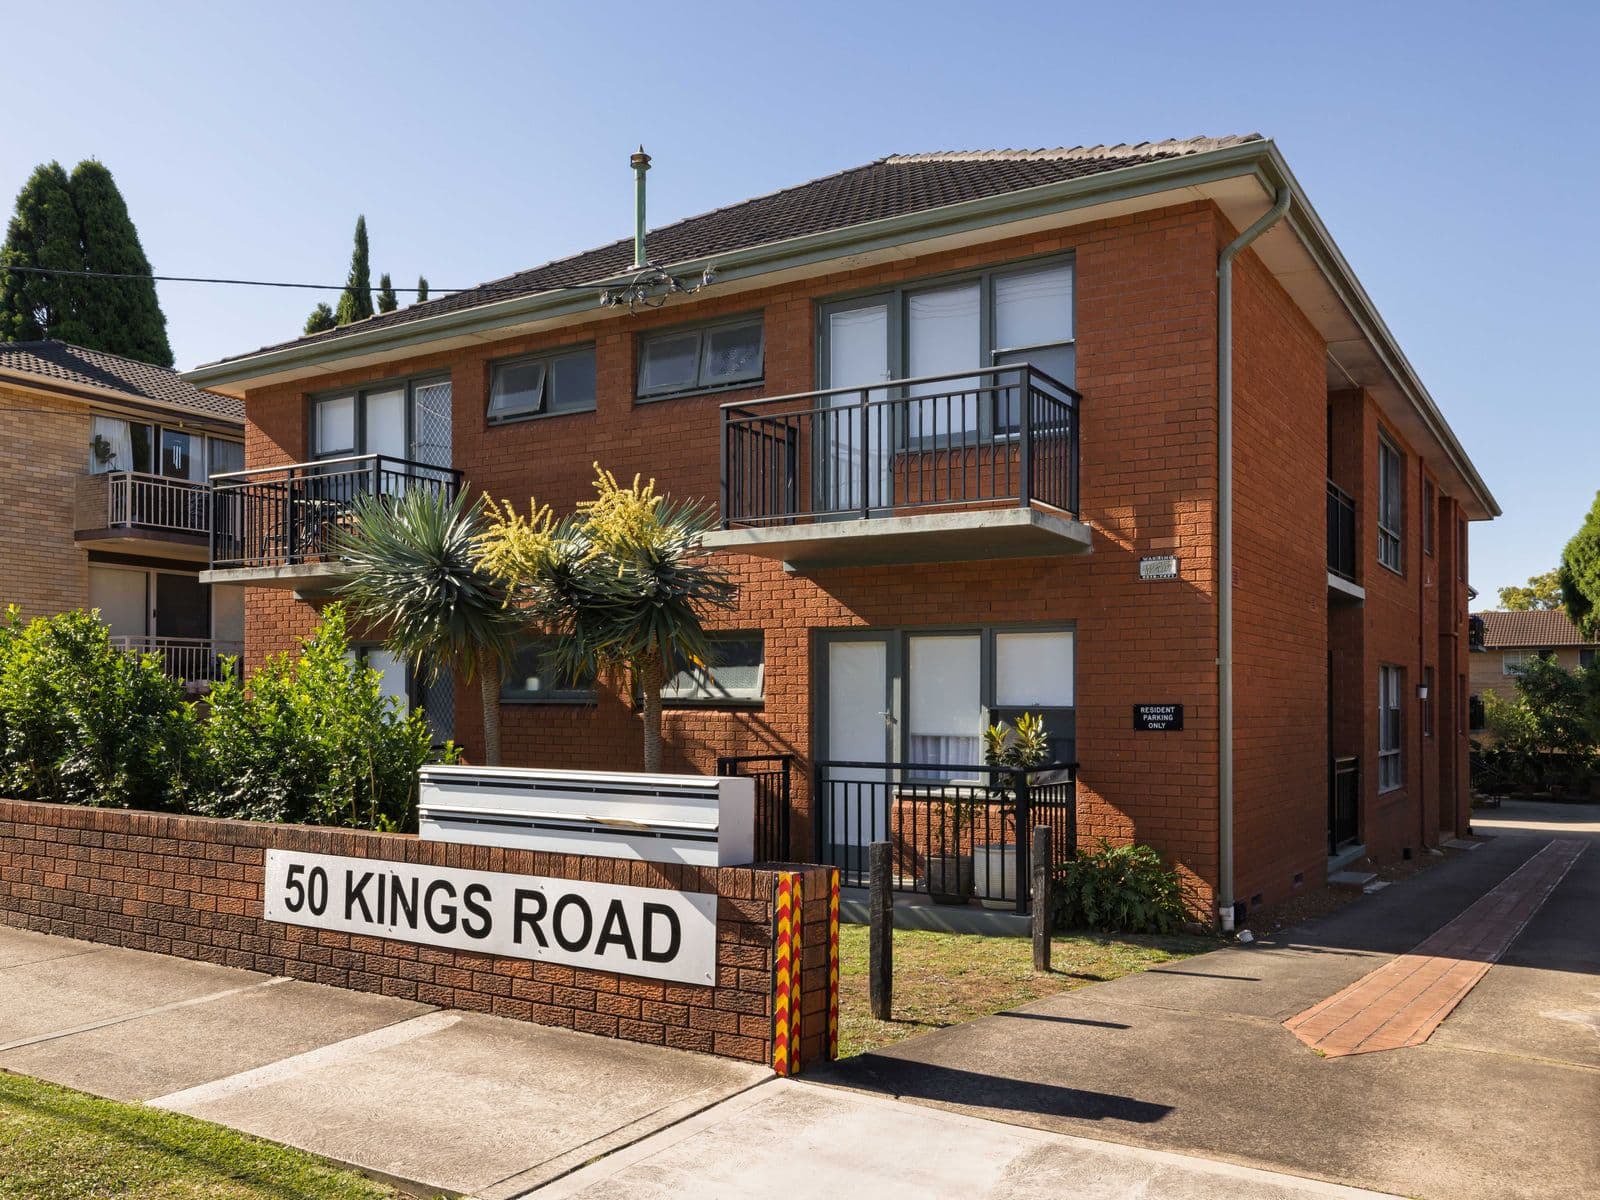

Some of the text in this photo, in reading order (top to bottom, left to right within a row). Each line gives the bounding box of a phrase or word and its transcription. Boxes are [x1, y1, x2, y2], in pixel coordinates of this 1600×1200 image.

[284, 864, 681, 963] 50 KINGS ROAD
